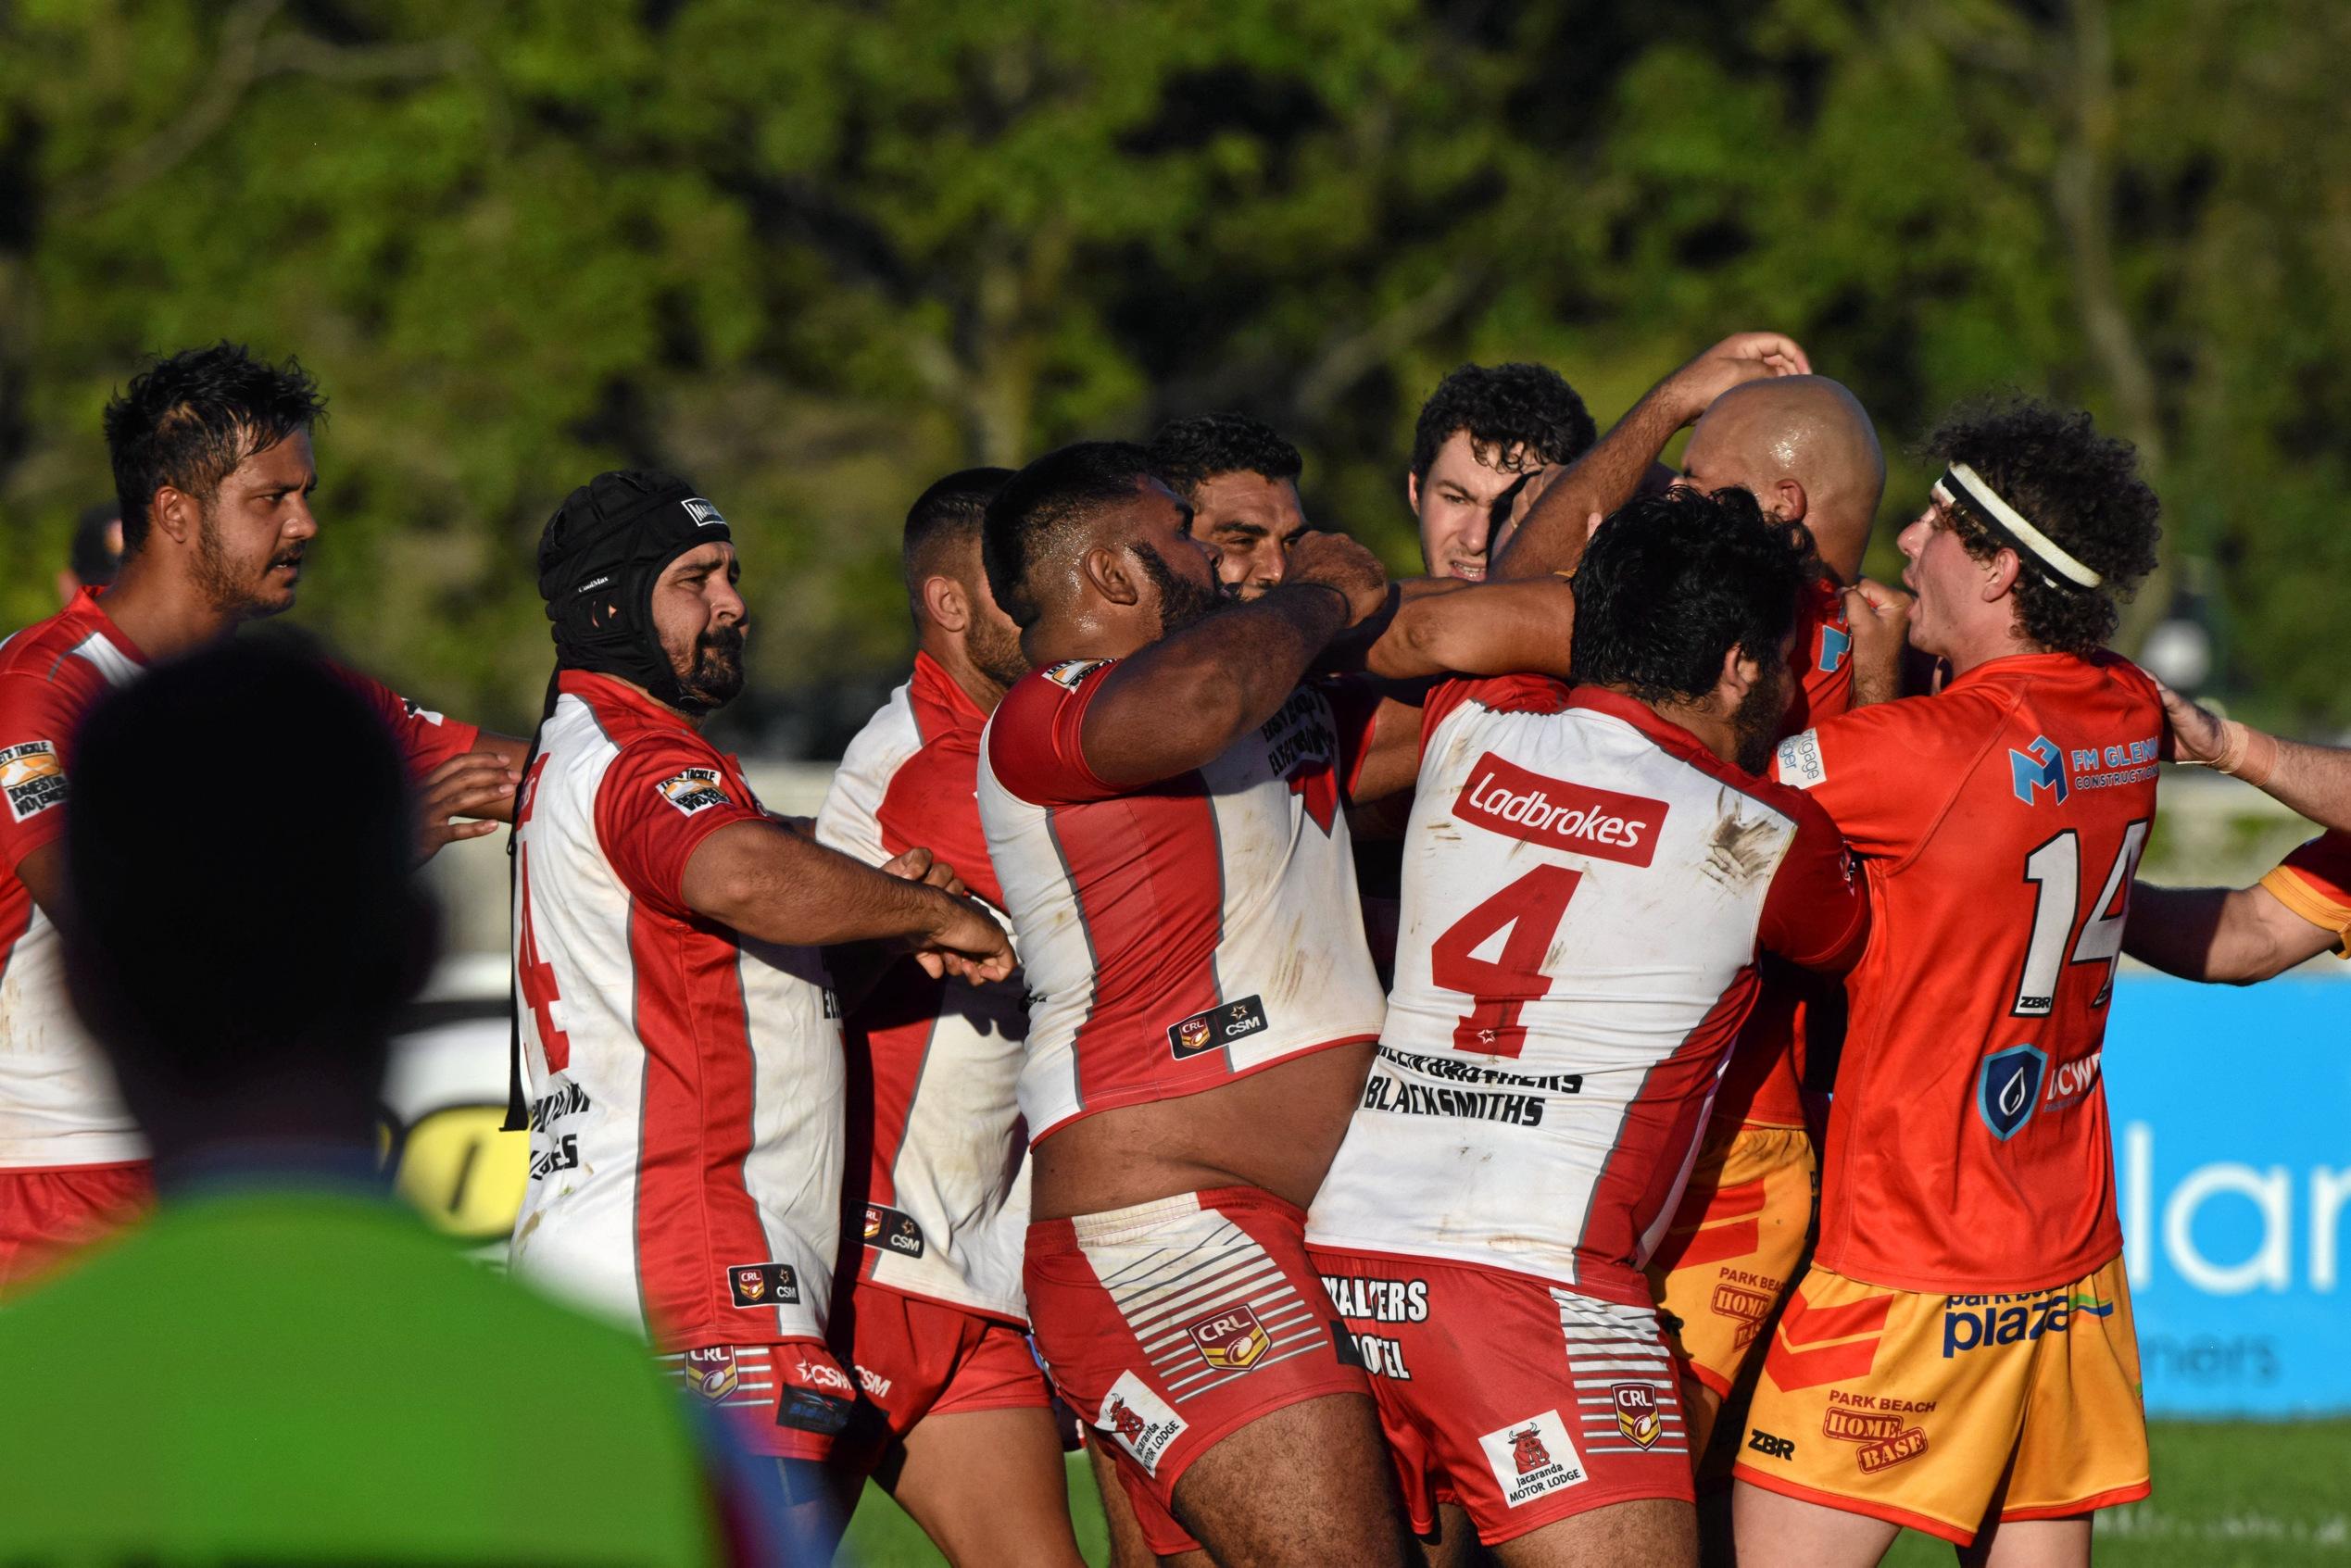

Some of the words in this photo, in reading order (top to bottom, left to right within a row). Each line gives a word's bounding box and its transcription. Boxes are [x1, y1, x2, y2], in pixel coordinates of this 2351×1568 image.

[2071, 748, 2100, 772] FM
[1468, 771, 1647, 848] Ladbrokes
[2009, 817, 2149, 1018] 14
[1431, 862, 1583, 1060] 4
[2020, 996, 2051, 1009] ZBR
[1182, 1021, 1204, 1034] CRL
[1226, 1016, 1261, 1035] CSM
[1364, 1075, 1546, 1127] BLACKSMITHS
[890, 1234, 920, 1252] CSM
[741, 1272, 761, 1282] CRL
[1719, 1267, 1758, 1287] PARK
[776, 1286, 797, 1298] CSM
[1198, 1314, 1251, 1342] CRL
[1942, 1295, 2068, 1359] plaza
[811, 1364, 853, 1390] CSM
[1618, 1390, 1653, 1407] CRL
[1829, 1389, 1877, 1409] PARK
[1879, 1399, 1937, 1413] BEACH
[1152, 1420, 1180, 1450] LODGE
[1829, 1413, 1899, 1438] HOME
[1748, 1428, 1795, 1461] ZBR
[1863, 1433, 1925, 1469] BASE
[1510, 1483, 1546, 1503] MOTOR
[1548, 1469, 1580, 1488] LODGE
[1516, 1463, 1564, 1488] Jacaranda
